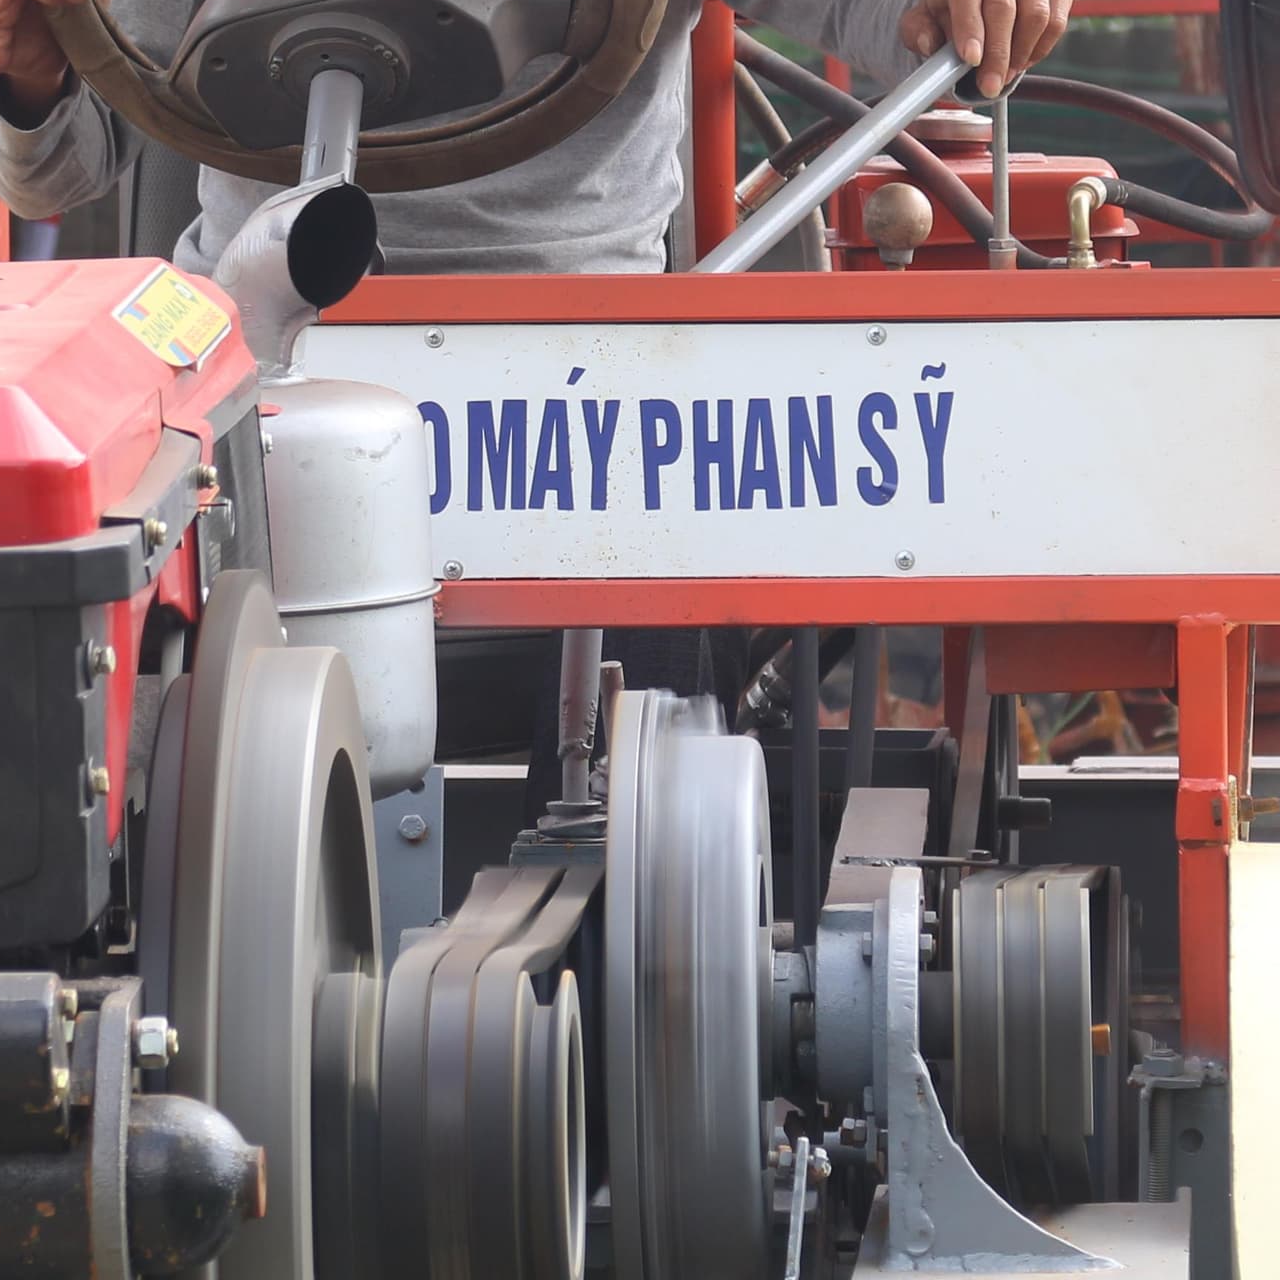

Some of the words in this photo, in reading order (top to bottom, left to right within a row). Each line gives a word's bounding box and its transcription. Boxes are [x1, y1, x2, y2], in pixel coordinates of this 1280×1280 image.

[467, 367, 620, 511] MÁY
[640, 395, 838, 511] PHAN
[856, 362, 954, 506] SỸ
